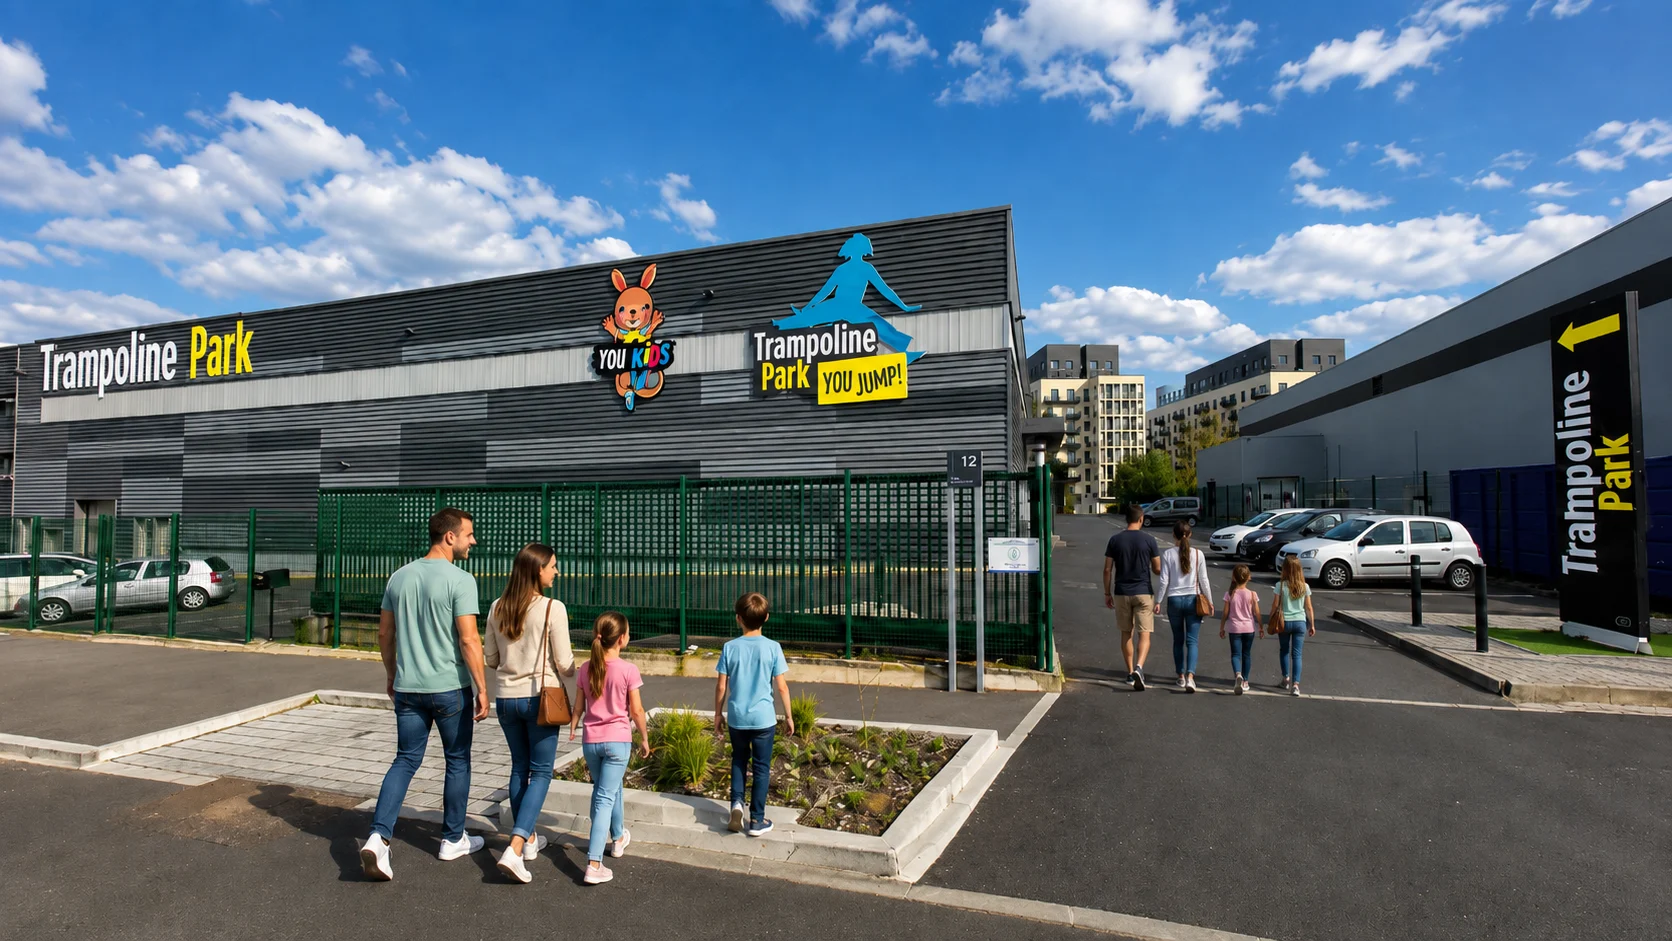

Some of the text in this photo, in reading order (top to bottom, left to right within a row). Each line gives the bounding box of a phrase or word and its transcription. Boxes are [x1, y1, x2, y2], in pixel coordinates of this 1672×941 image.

[40, 320, 254, 399] Trampoline Park
[599, 348, 626, 370] YOU
[754, 323, 877, 363] Trampoline
[761, 359, 811, 391] Park
[822, 363, 903, 397] YOU JUMP!
[961, 455, 977, 467] 12
[1555, 370, 1604, 575] Trampoline
[1594, 433, 1634, 511] Park
